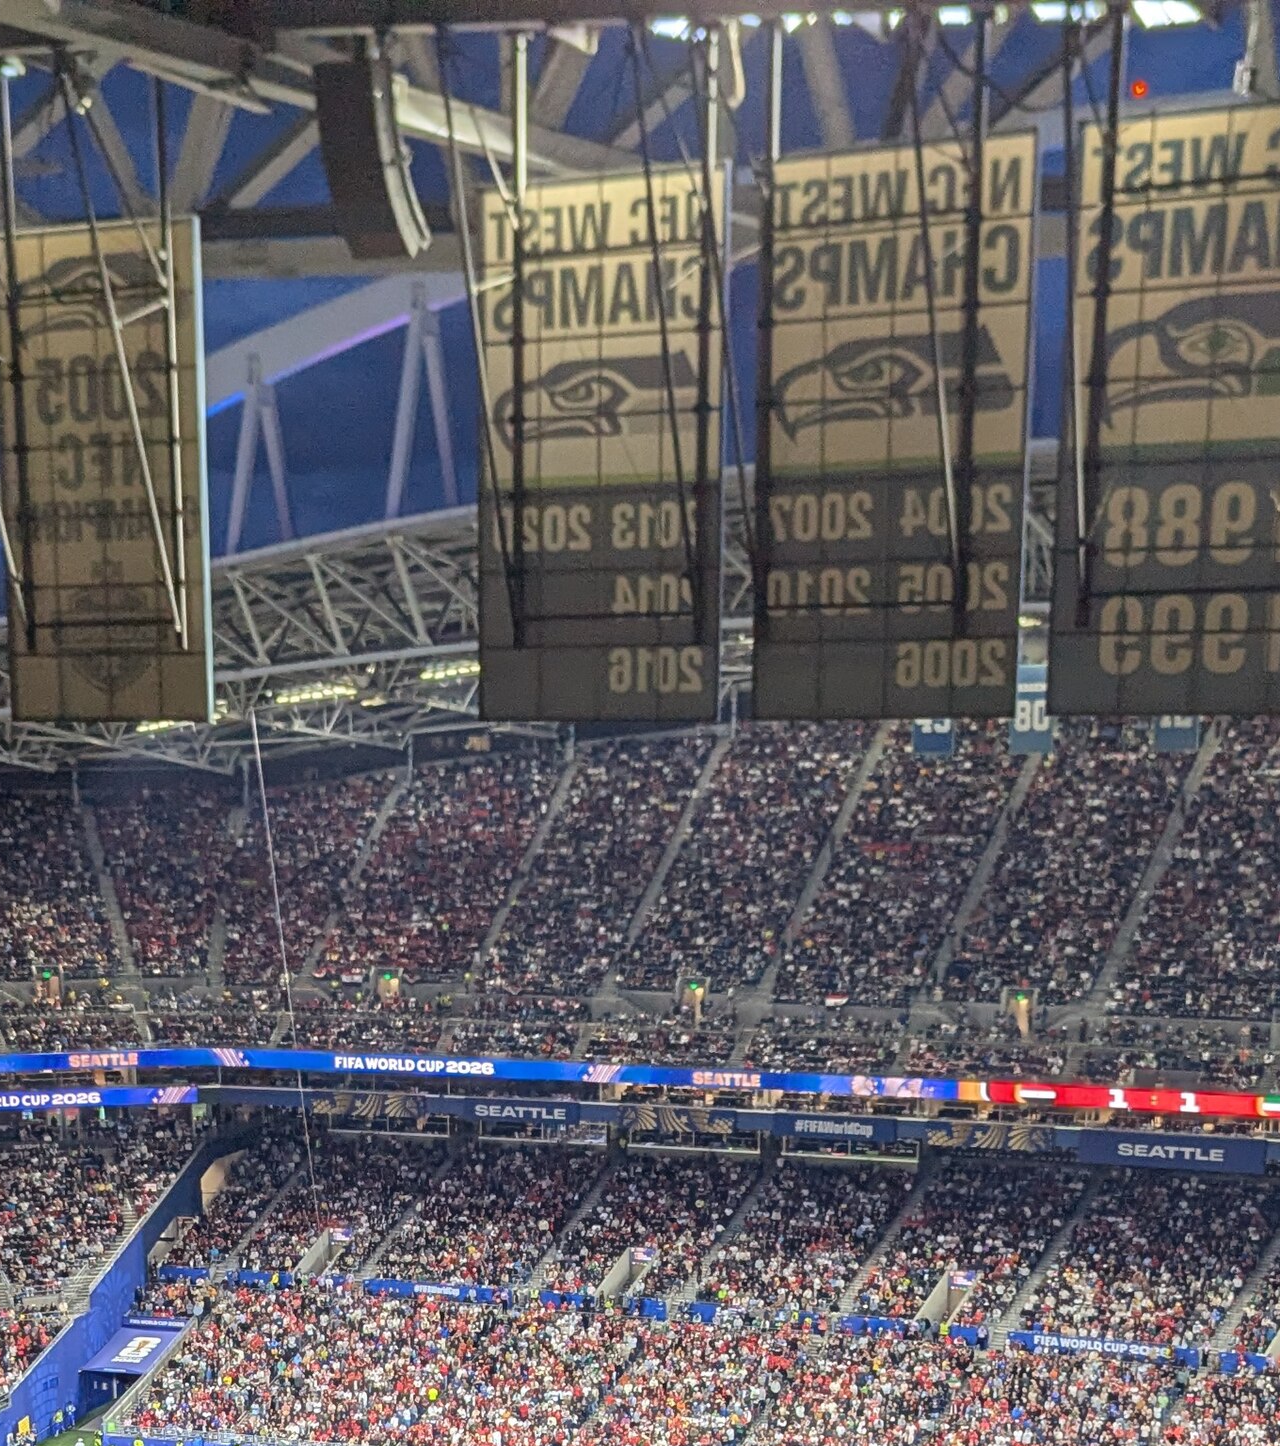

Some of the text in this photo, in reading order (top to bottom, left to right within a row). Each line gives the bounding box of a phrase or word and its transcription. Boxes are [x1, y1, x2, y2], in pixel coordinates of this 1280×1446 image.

[1014, 700, 1049, 732] 80
[68, 1052, 139, 1069] SEATTLE
[334, 1055, 494, 1077] FIFA WORLD CUP 2026
[692, 1070, 761, 1088] SEATTLE
[21, 1093, 50, 1108] CUP
[52, 1091, 102, 1106] 2026
[1108, 1088, 1200, 1113] 1 1
[474, 1103, 567, 1121] SEATTLE
[793, 1118, 873, 1140] #FIFAWorldCup
[1117, 1142, 1224, 1163] SEATTLE
[1033, 1334, 1170, 1358] FIFA WORLD CUP 206
